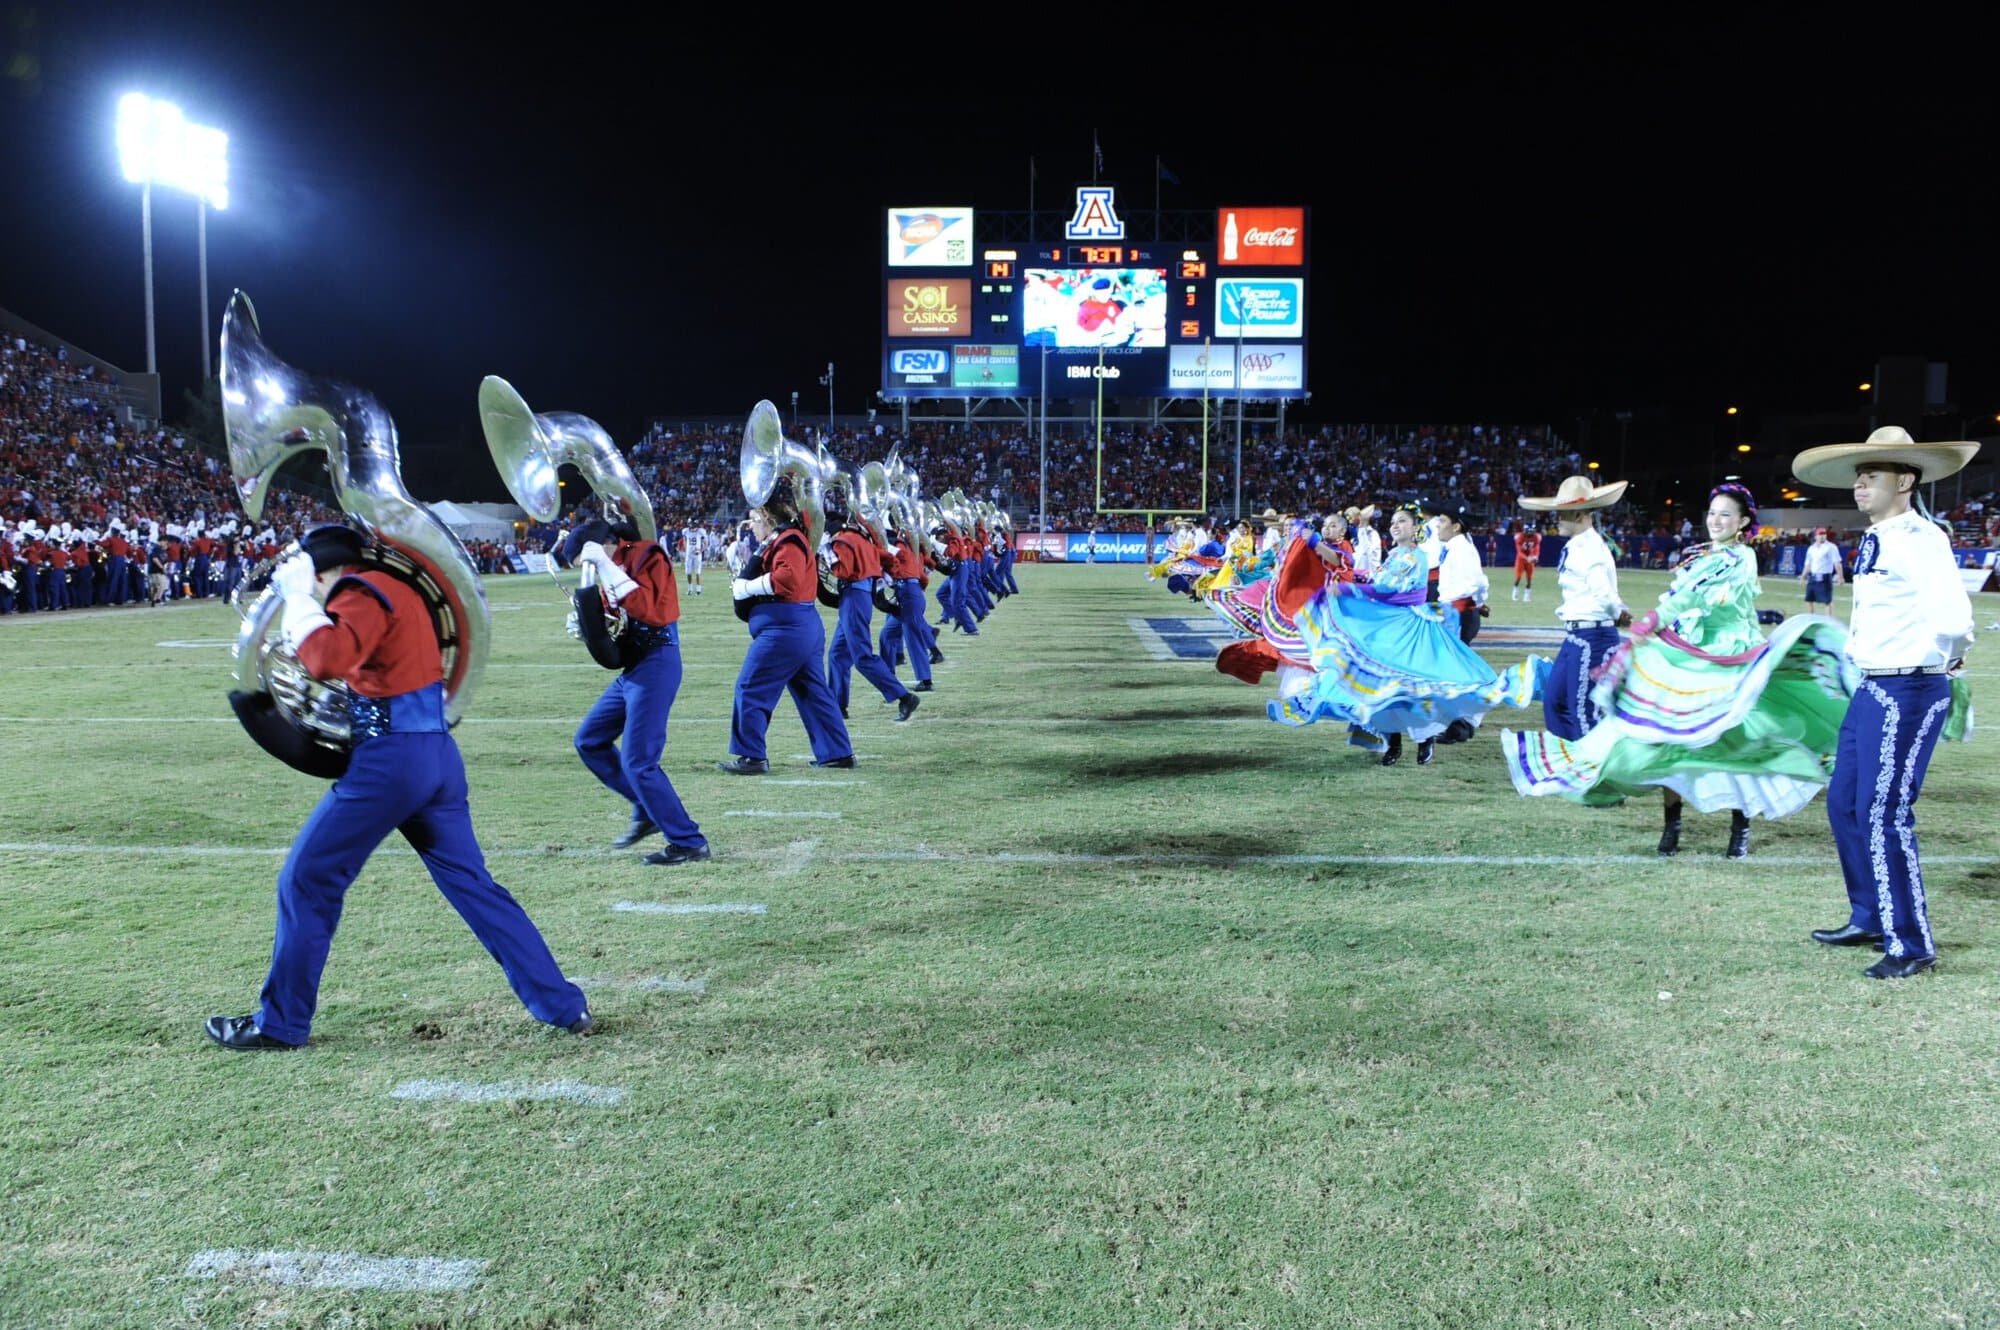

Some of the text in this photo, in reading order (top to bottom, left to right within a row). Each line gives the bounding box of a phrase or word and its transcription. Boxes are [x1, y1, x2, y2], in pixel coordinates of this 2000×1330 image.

[1065, 187, 1124, 240] A
[1052, 250, 1060, 261] 3
[1080, 247, 1122, 264] 7:37
[1130, 250, 1138, 261] 3
[992, 263, 1008, 276] 14
[1183, 263, 1205, 277] 24
[903, 285, 958, 311] SOL
[1240, 286, 1281, 298] Tucson
[1187, 294, 1195, 306] 3
[1243, 298, 1291, 309] Electric
[903, 312, 958, 324] CASINOS
[1248, 309, 1291, 320] Power
[1182, 321, 1199, 336] 25
[900, 352, 940, 370] FSN
[956, 356, 1016, 364] CAR CARE CENTERS
[1067, 366, 1120, 378] IBM Club
